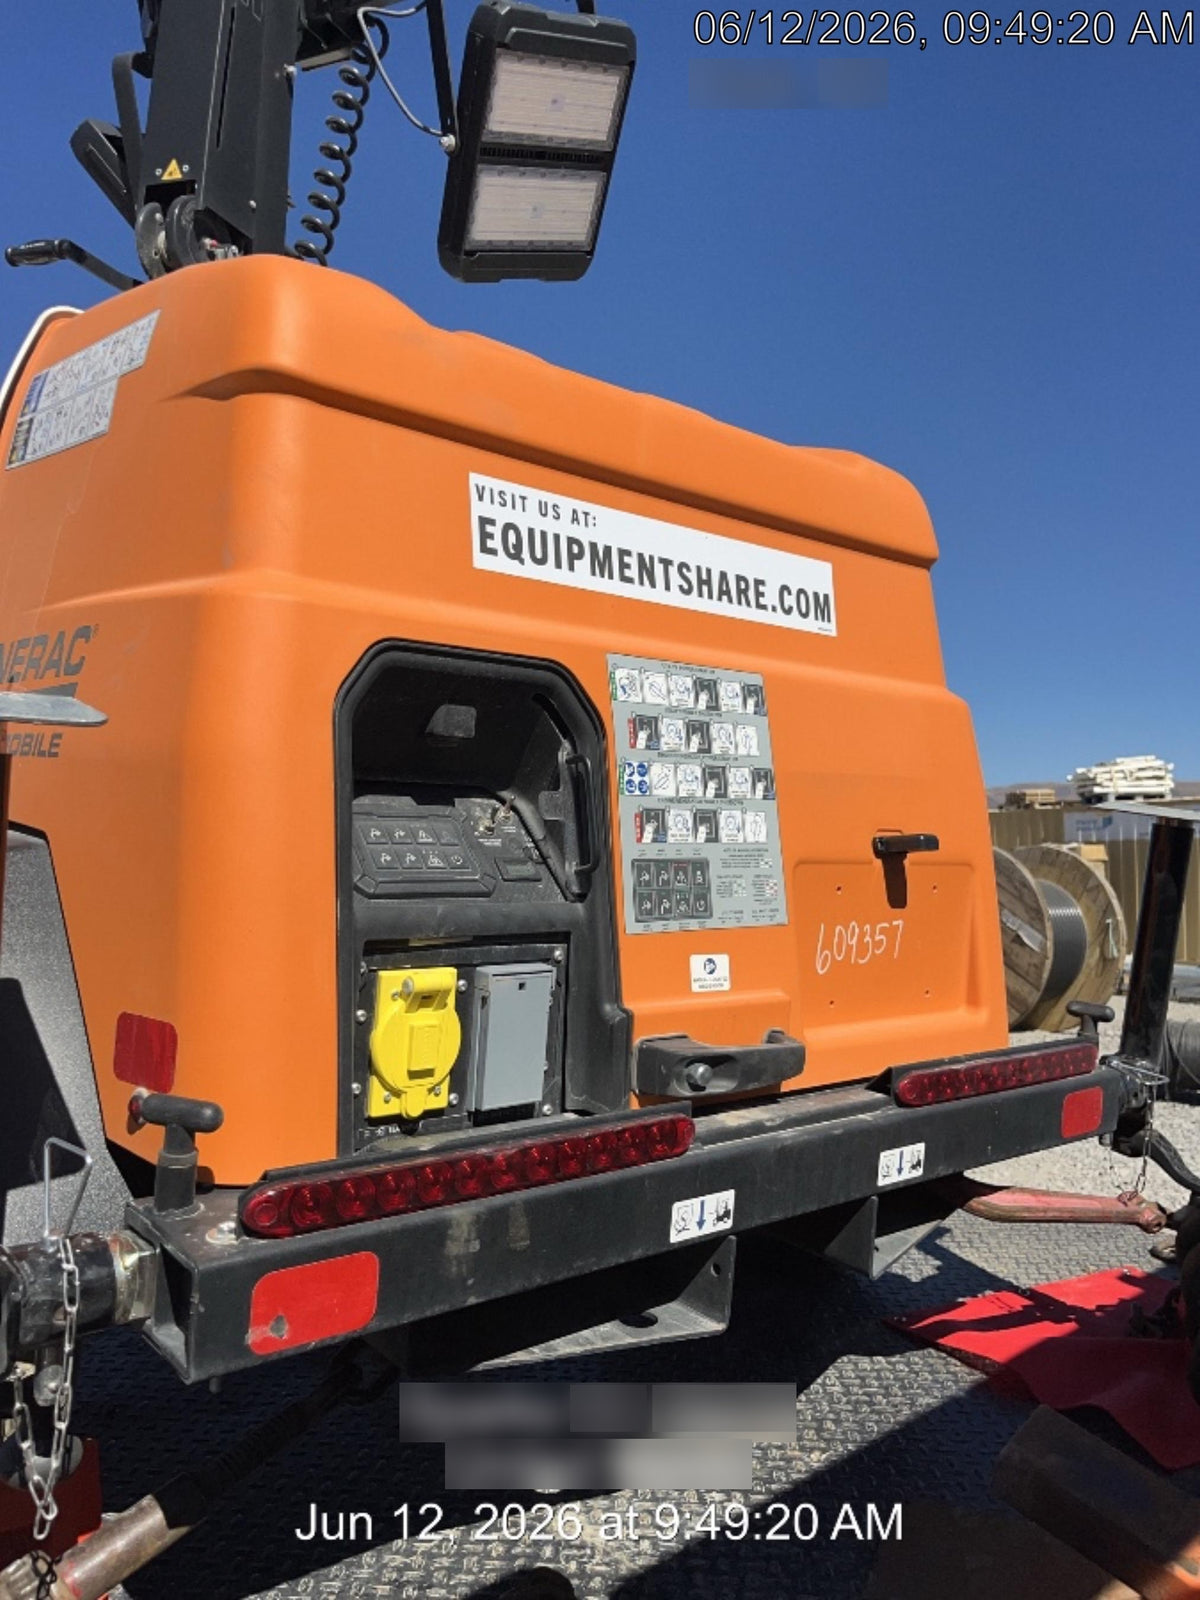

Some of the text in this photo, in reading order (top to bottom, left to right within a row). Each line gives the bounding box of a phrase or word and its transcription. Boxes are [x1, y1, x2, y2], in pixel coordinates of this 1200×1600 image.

[475, 483, 597, 528] VISIT US AT:
[478, 515, 832, 623] EQUIPMENTSHARE.COM
[7, 733, 63, 758] OBILE
[815, 919, 904, 975] 609357
